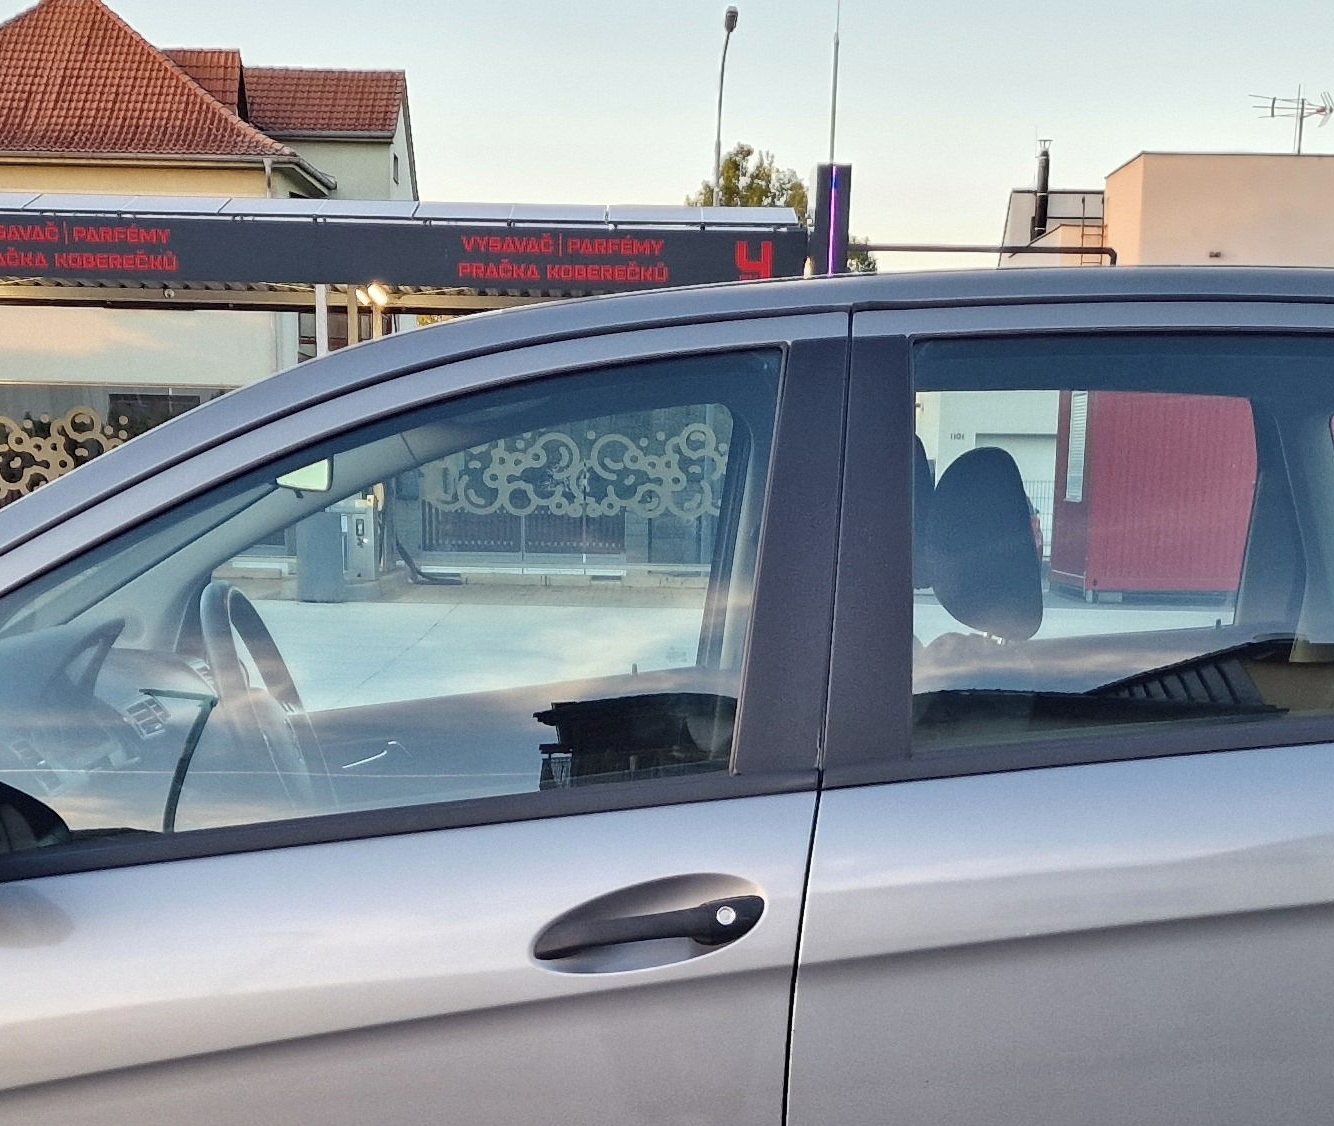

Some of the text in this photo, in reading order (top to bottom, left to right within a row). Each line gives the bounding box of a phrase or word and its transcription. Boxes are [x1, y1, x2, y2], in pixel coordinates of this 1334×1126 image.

[73, 223, 171, 244] PARFÉMY
[460, 233, 555, 254] VYSAVAČ
[569, 235, 665, 256] PARFÉMY
[55, 250, 178, 271] KOBEREČKŮ
[458, 259, 669, 282] PRAČKA KOBEREČKŮ
[735, 240, 773, 281] 4
